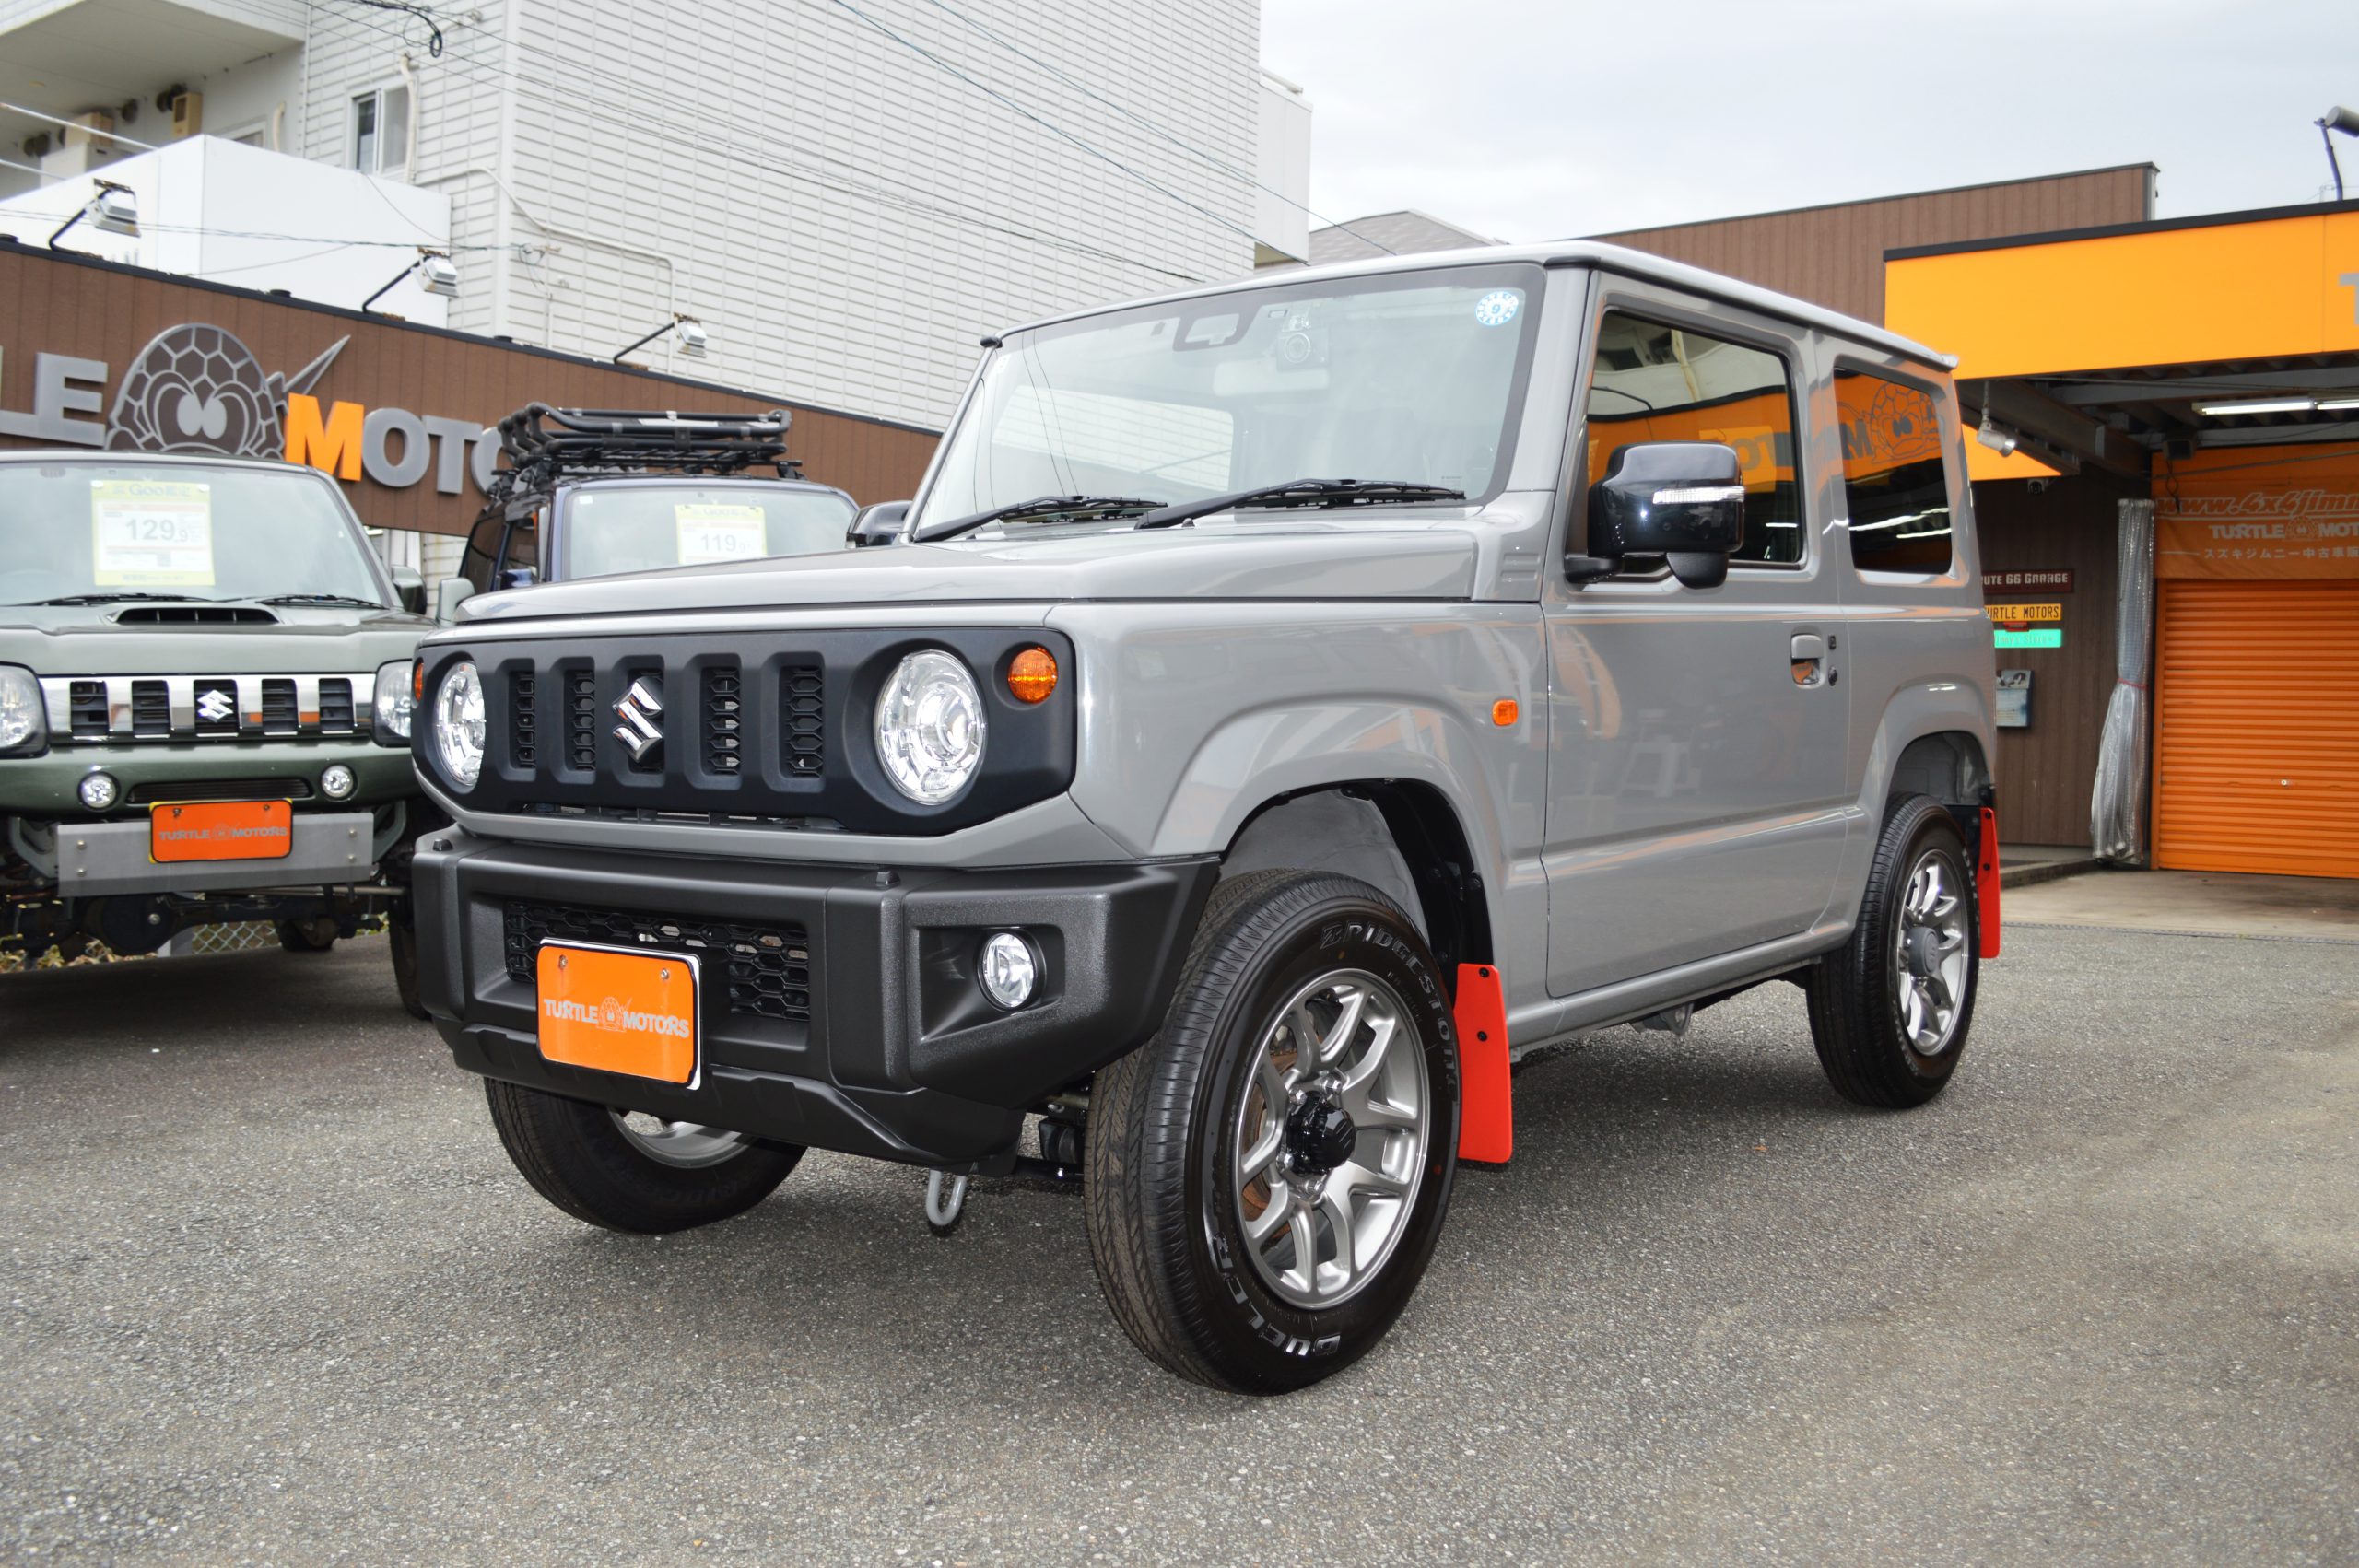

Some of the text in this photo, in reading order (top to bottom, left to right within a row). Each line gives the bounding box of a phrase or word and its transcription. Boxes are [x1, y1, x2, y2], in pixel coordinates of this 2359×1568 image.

[2211, 523, 2285, 539] TURTLE
[1982, 575, 2002, 585] UTE
[2006, 573, 2021, 585] 66
[1986, 606, 2059, 620] URTLE MOTORS
[158, 826, 288, 840] TURTLE MOTORS
[544, 999, 689, 1038] TURTLE MOTORS
